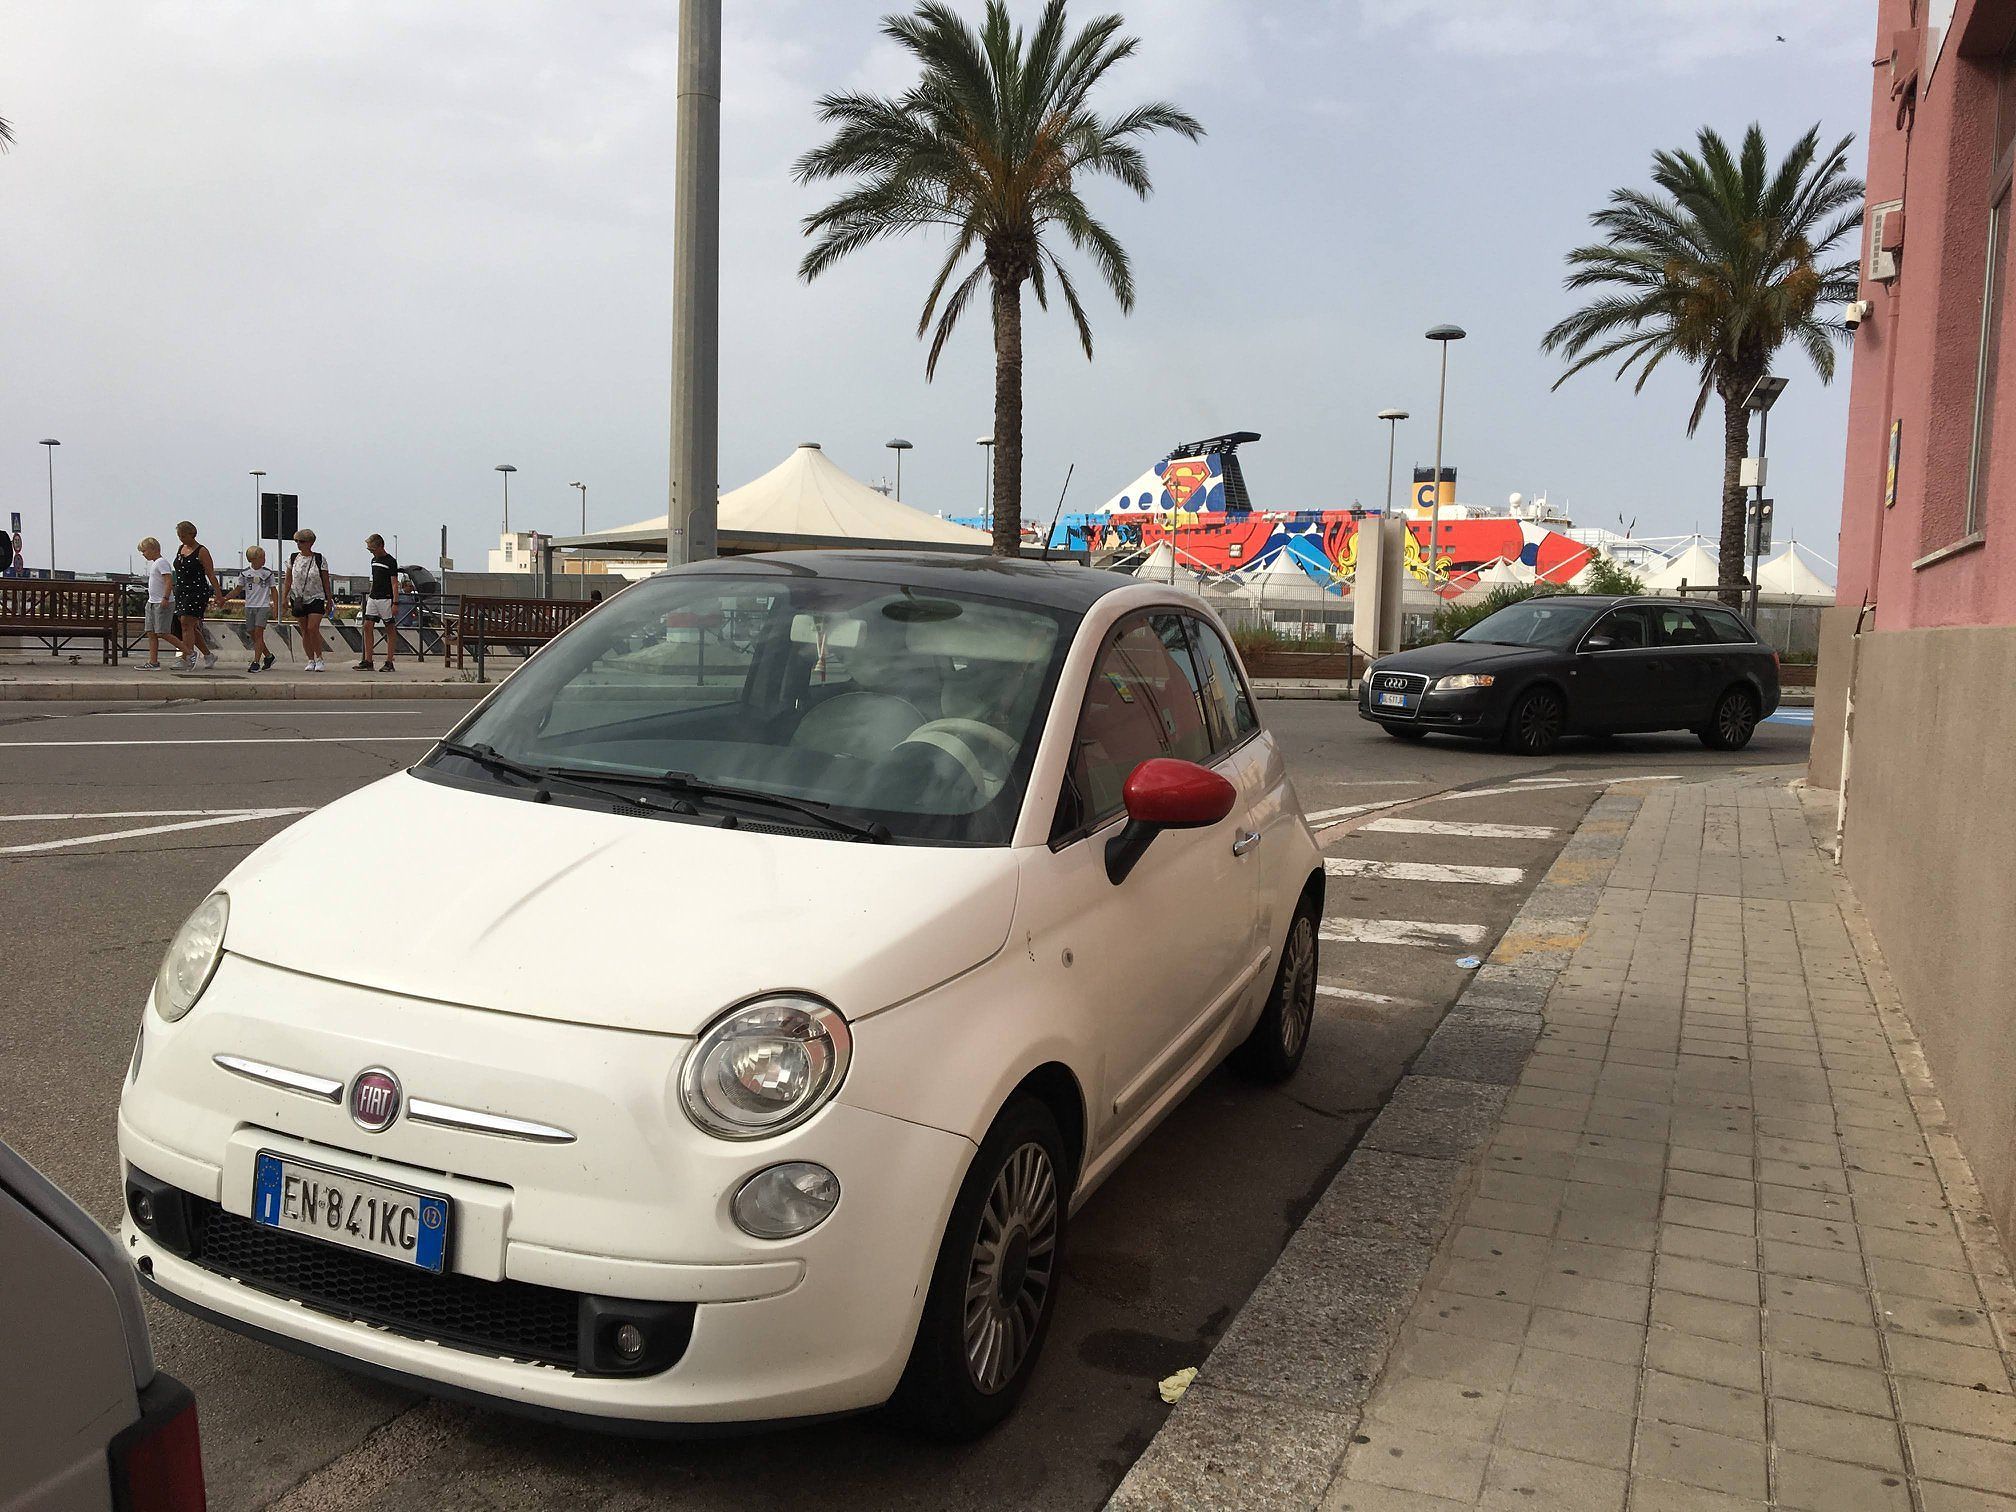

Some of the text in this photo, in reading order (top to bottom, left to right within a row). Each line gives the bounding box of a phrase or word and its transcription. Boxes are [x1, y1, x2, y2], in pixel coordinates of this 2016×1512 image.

[1417, 484, 1435, 508] C
[359, 1085, 391, 1116] FIAT
[425, 1209, 437, 1224] 12
